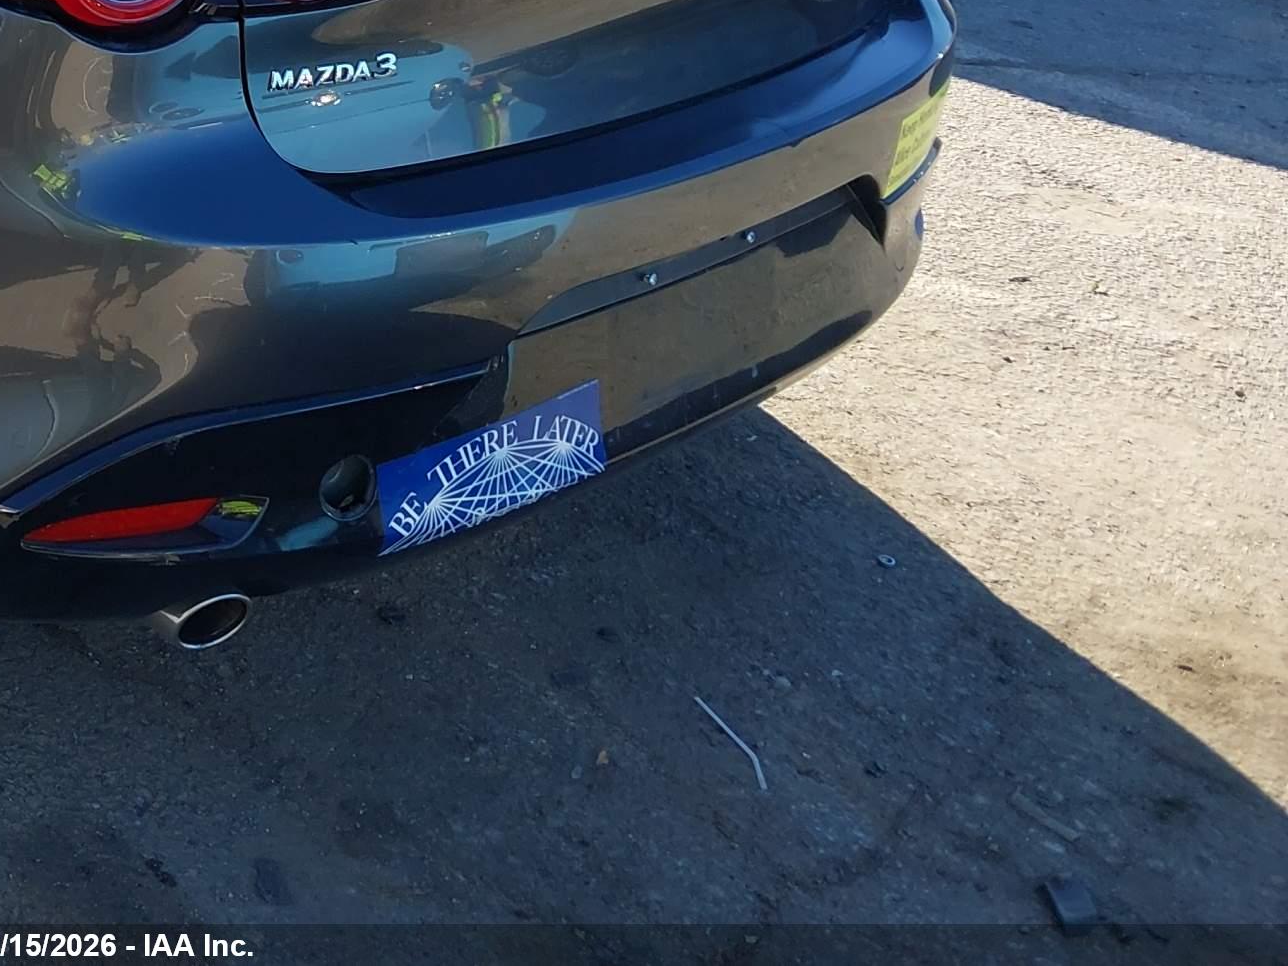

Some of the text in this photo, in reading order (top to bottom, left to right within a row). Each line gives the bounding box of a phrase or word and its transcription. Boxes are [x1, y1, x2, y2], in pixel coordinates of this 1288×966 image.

[388, 414, 600, 538] BE THERE LATER
